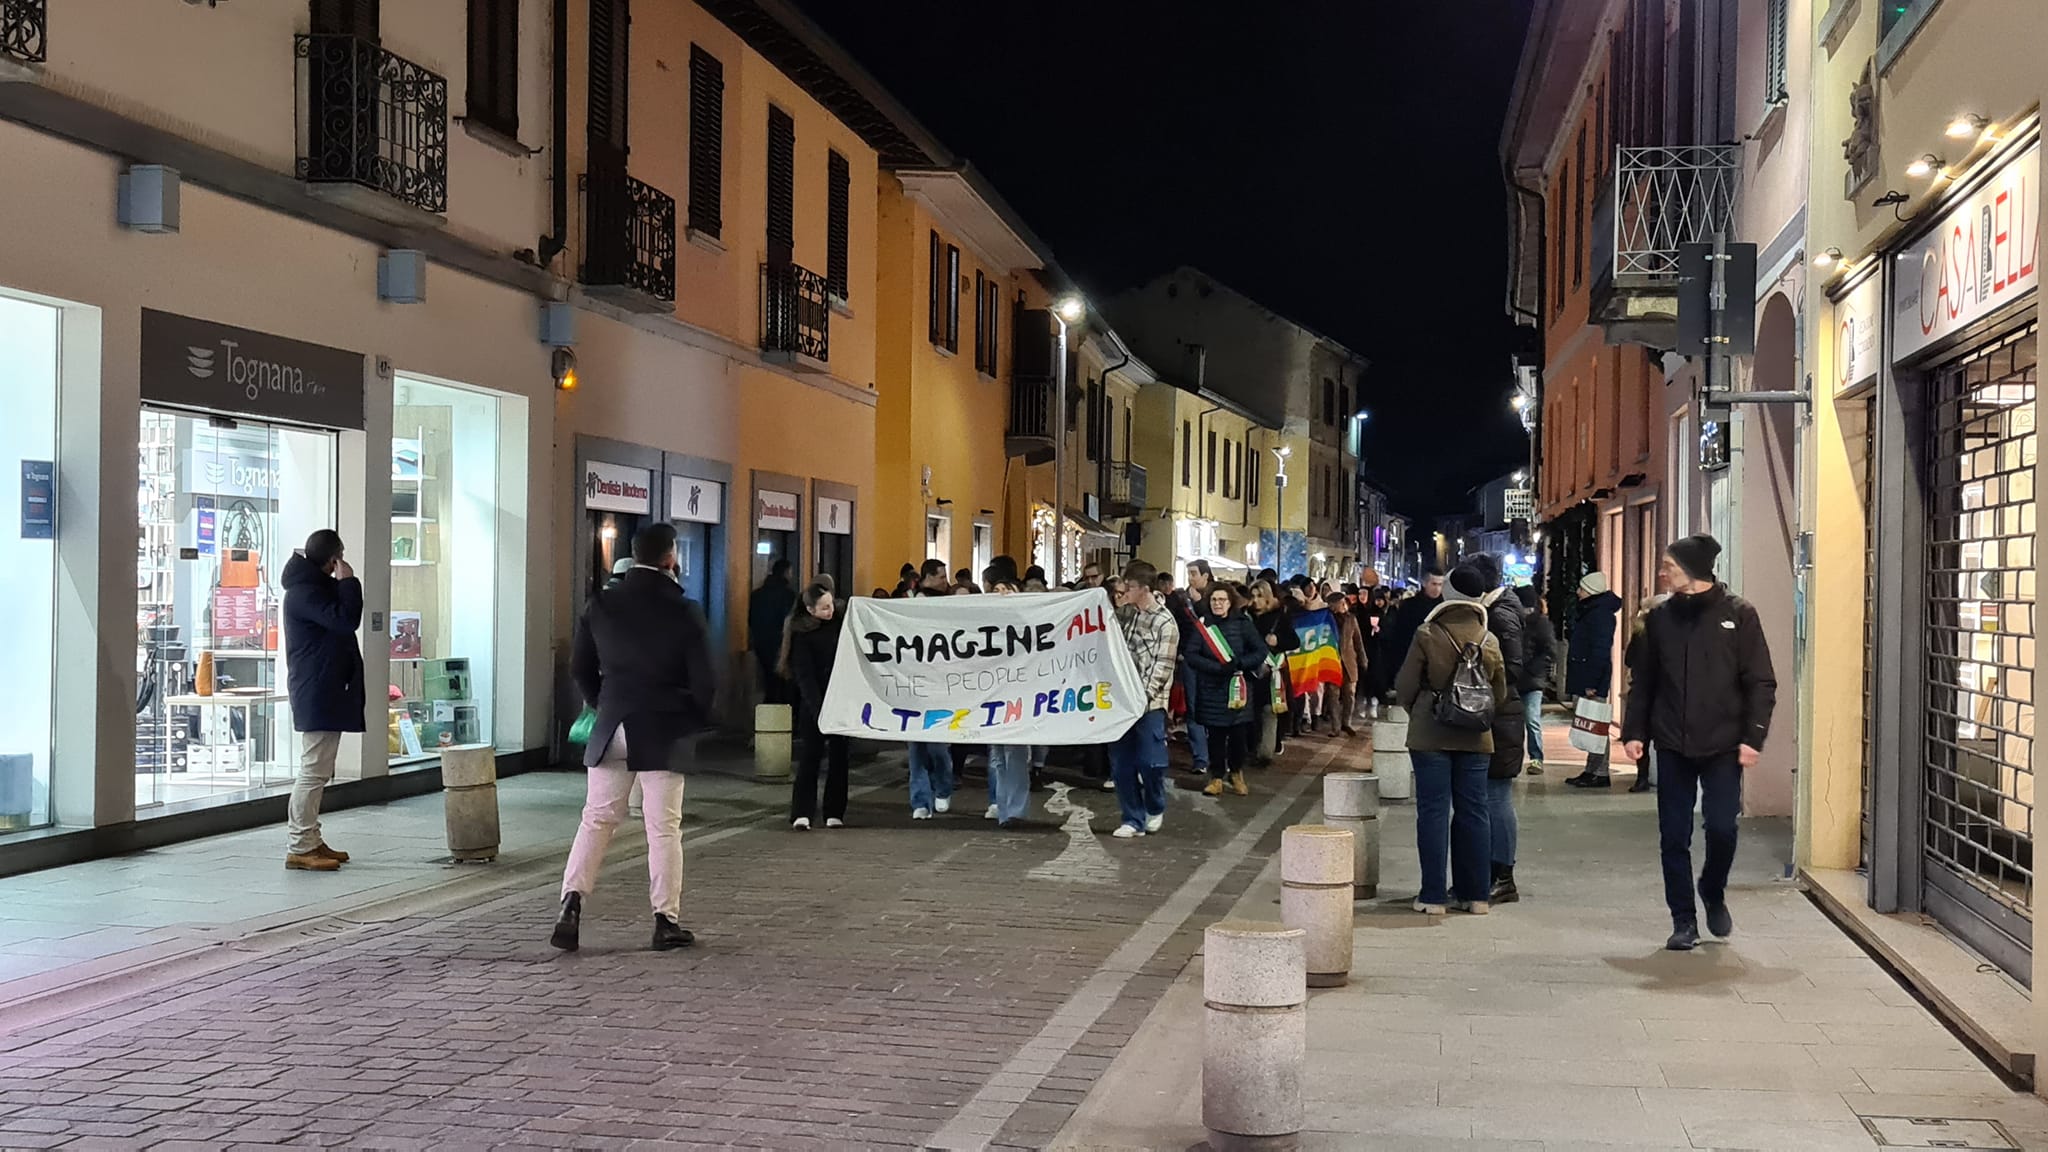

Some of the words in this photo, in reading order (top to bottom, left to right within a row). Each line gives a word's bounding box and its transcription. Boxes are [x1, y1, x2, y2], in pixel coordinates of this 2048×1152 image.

[220, 339, 303, 400] Tognana
[864, 622, 1055, 664] IMAGINE
[879, 674, 928, 698] THE
[946, 666, 1027, 696] PEOPLE
[1038, 647, 1098, 677] LIVING
[980, 697, 1023, 727] IN
[1033, 681, 1112, 717] PEACE
